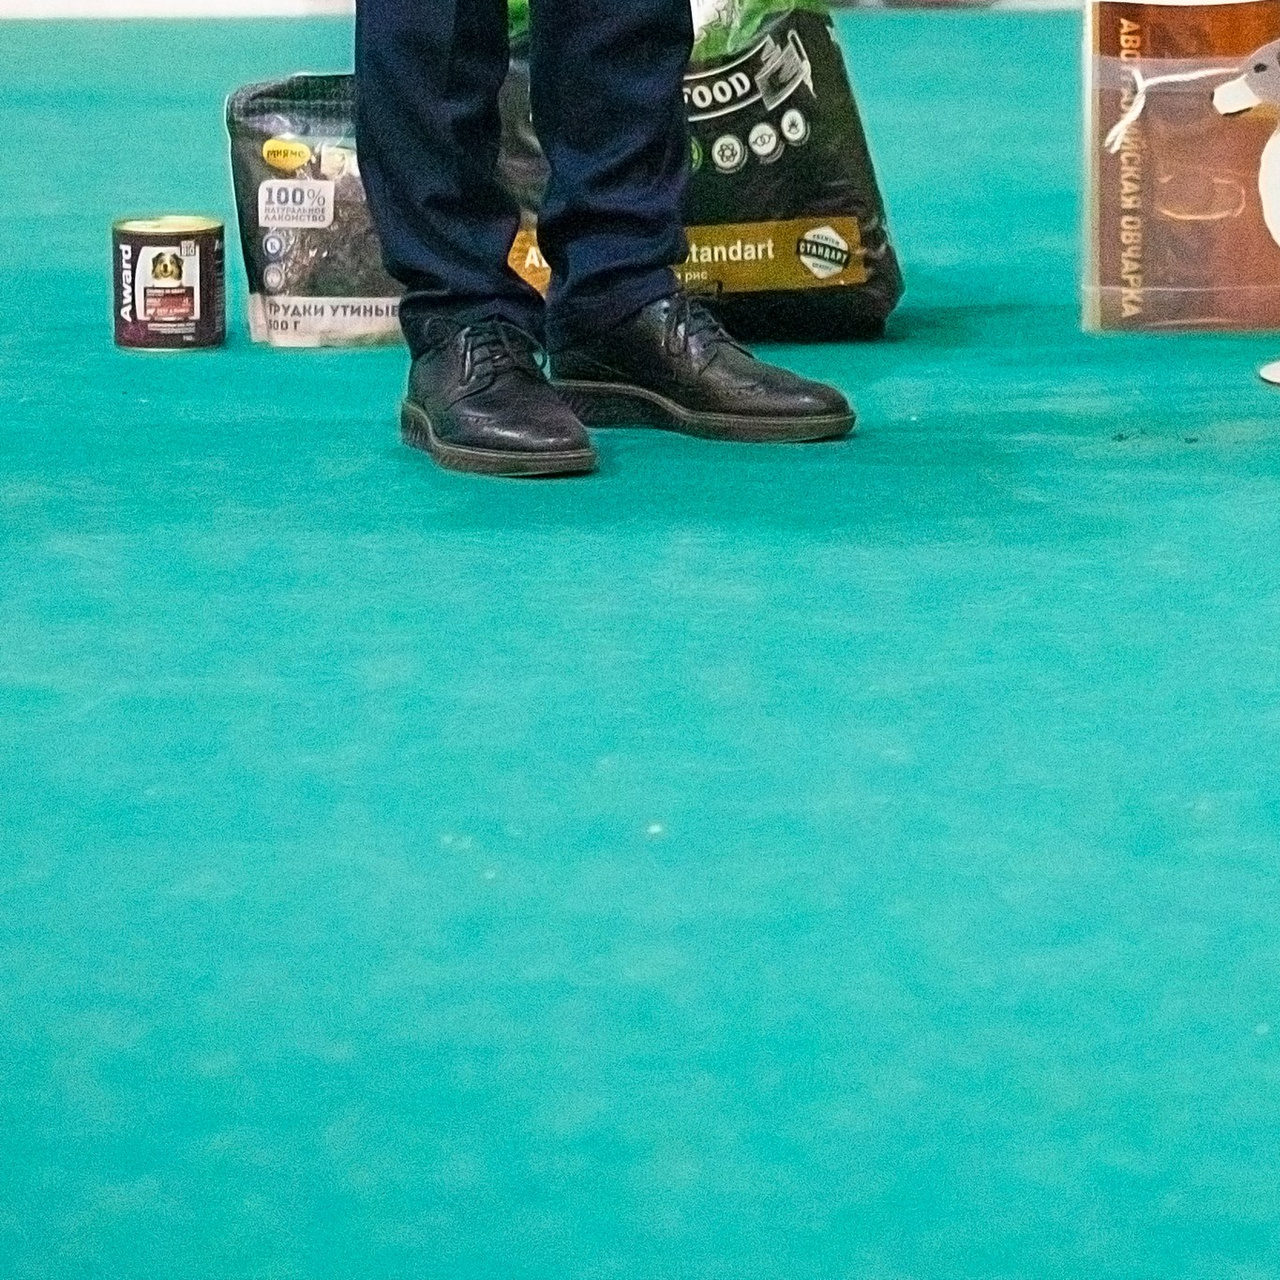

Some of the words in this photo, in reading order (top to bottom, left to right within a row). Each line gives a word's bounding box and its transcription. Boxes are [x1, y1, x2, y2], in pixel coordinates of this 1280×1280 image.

[264, 187, 326, 207] 100%
[264, 207, 326, 215] НАТУРАЛЬНОЕ
[264, 214, 326, 223] ЛАКОМСТВО
[685, 239, 775, 264] tandart
[799, 241, 848, 264] СТАНДАРТ
[1121, 216, 1142, 318] ОВЧАРКА
[119, 243, 132, 323] Award
[685, 272, 707, 283] рис
[330, 304, 399, 317] УТИНЫЕ
